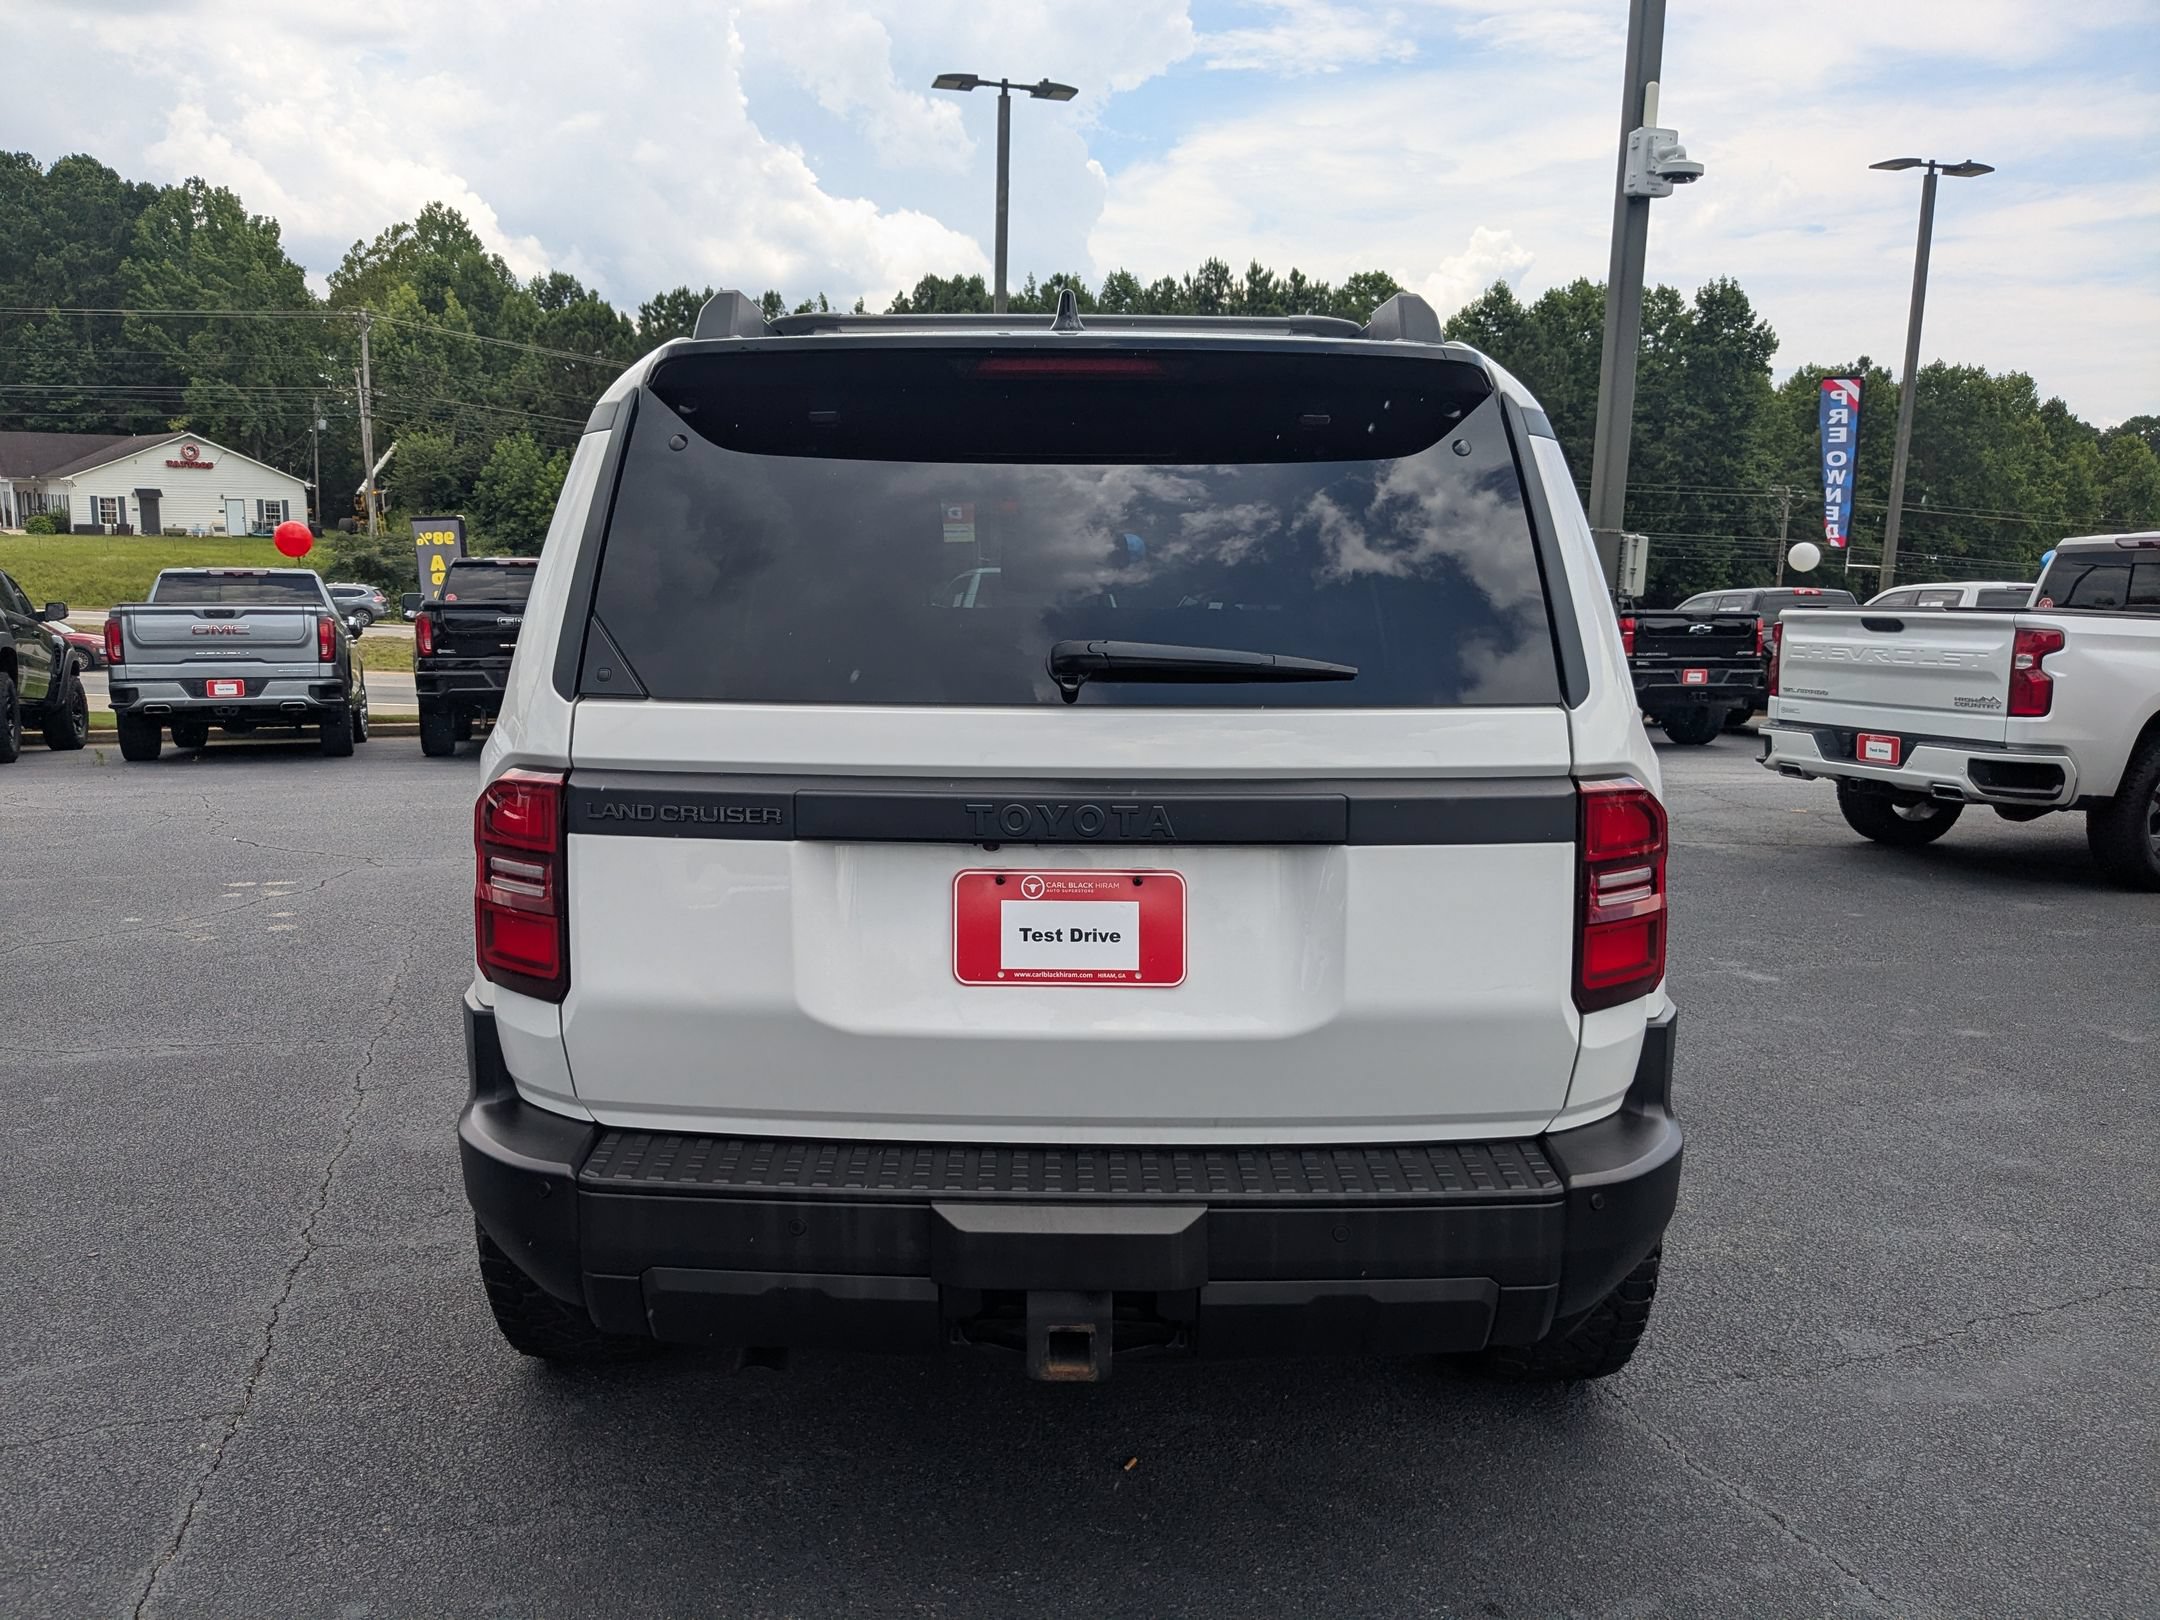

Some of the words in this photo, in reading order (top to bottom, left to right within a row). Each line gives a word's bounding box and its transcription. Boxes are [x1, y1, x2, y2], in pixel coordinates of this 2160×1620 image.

[192, 624, 250, 635] GMC
[1789, 644, 1989, 668] CHEVROLET
[586, 802, 655, 820] LAND
[659, 804, 783, 824] CRUISER
[965, 803, 1177, 838] TOYOTA
[1046, 881, 1067, 889] CARL
[1019, 927, 1063, 942] Test
[1070, 928, 1121, 943] Drive
[1014, 971, 1093, 979] www.carlblackhiram.com
